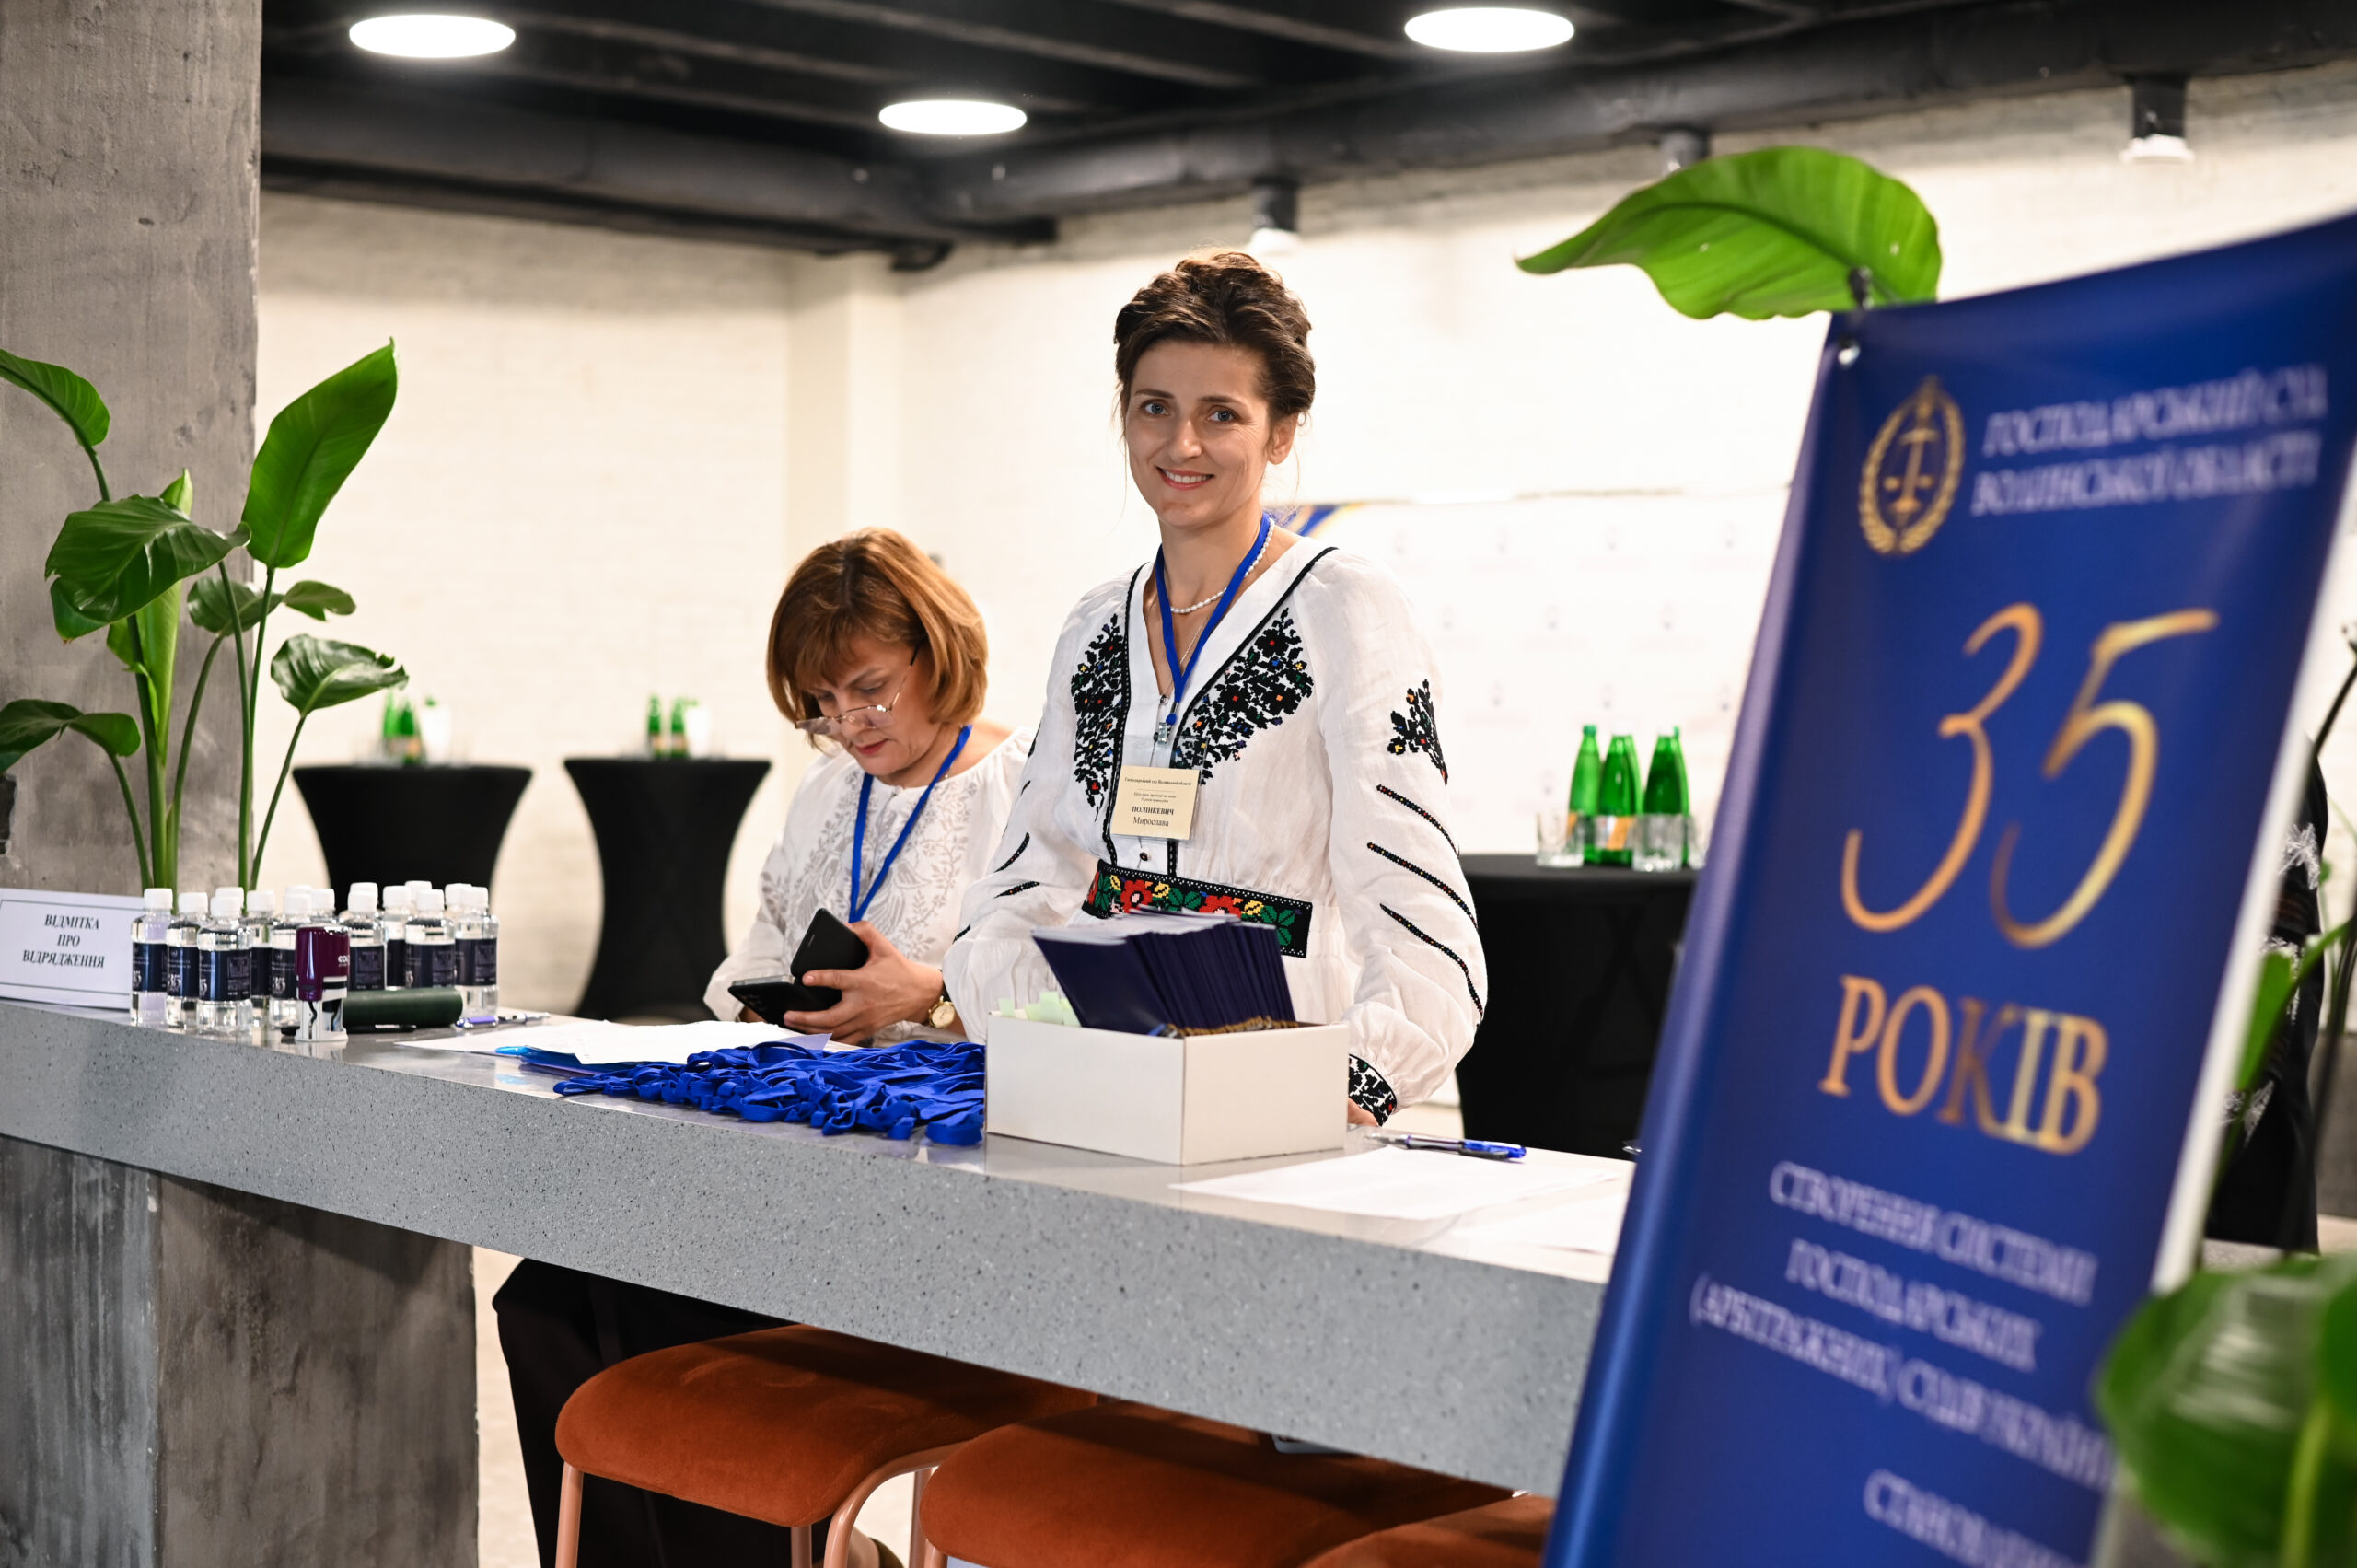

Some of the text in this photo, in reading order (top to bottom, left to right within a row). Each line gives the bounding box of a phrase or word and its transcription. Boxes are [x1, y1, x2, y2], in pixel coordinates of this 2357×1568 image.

[1841, 602, 2218, 950] 35
[1132, 816, 1169, 827] Мирослава
[44, 914, 99, 930] ВІДМІТКА
[57, 934, 80, 947] ПРО
[22, 949, 105, 969] ВІДРЯДЖЕННЯ
[1817, 972, 2109, 1156] РОКІВ
